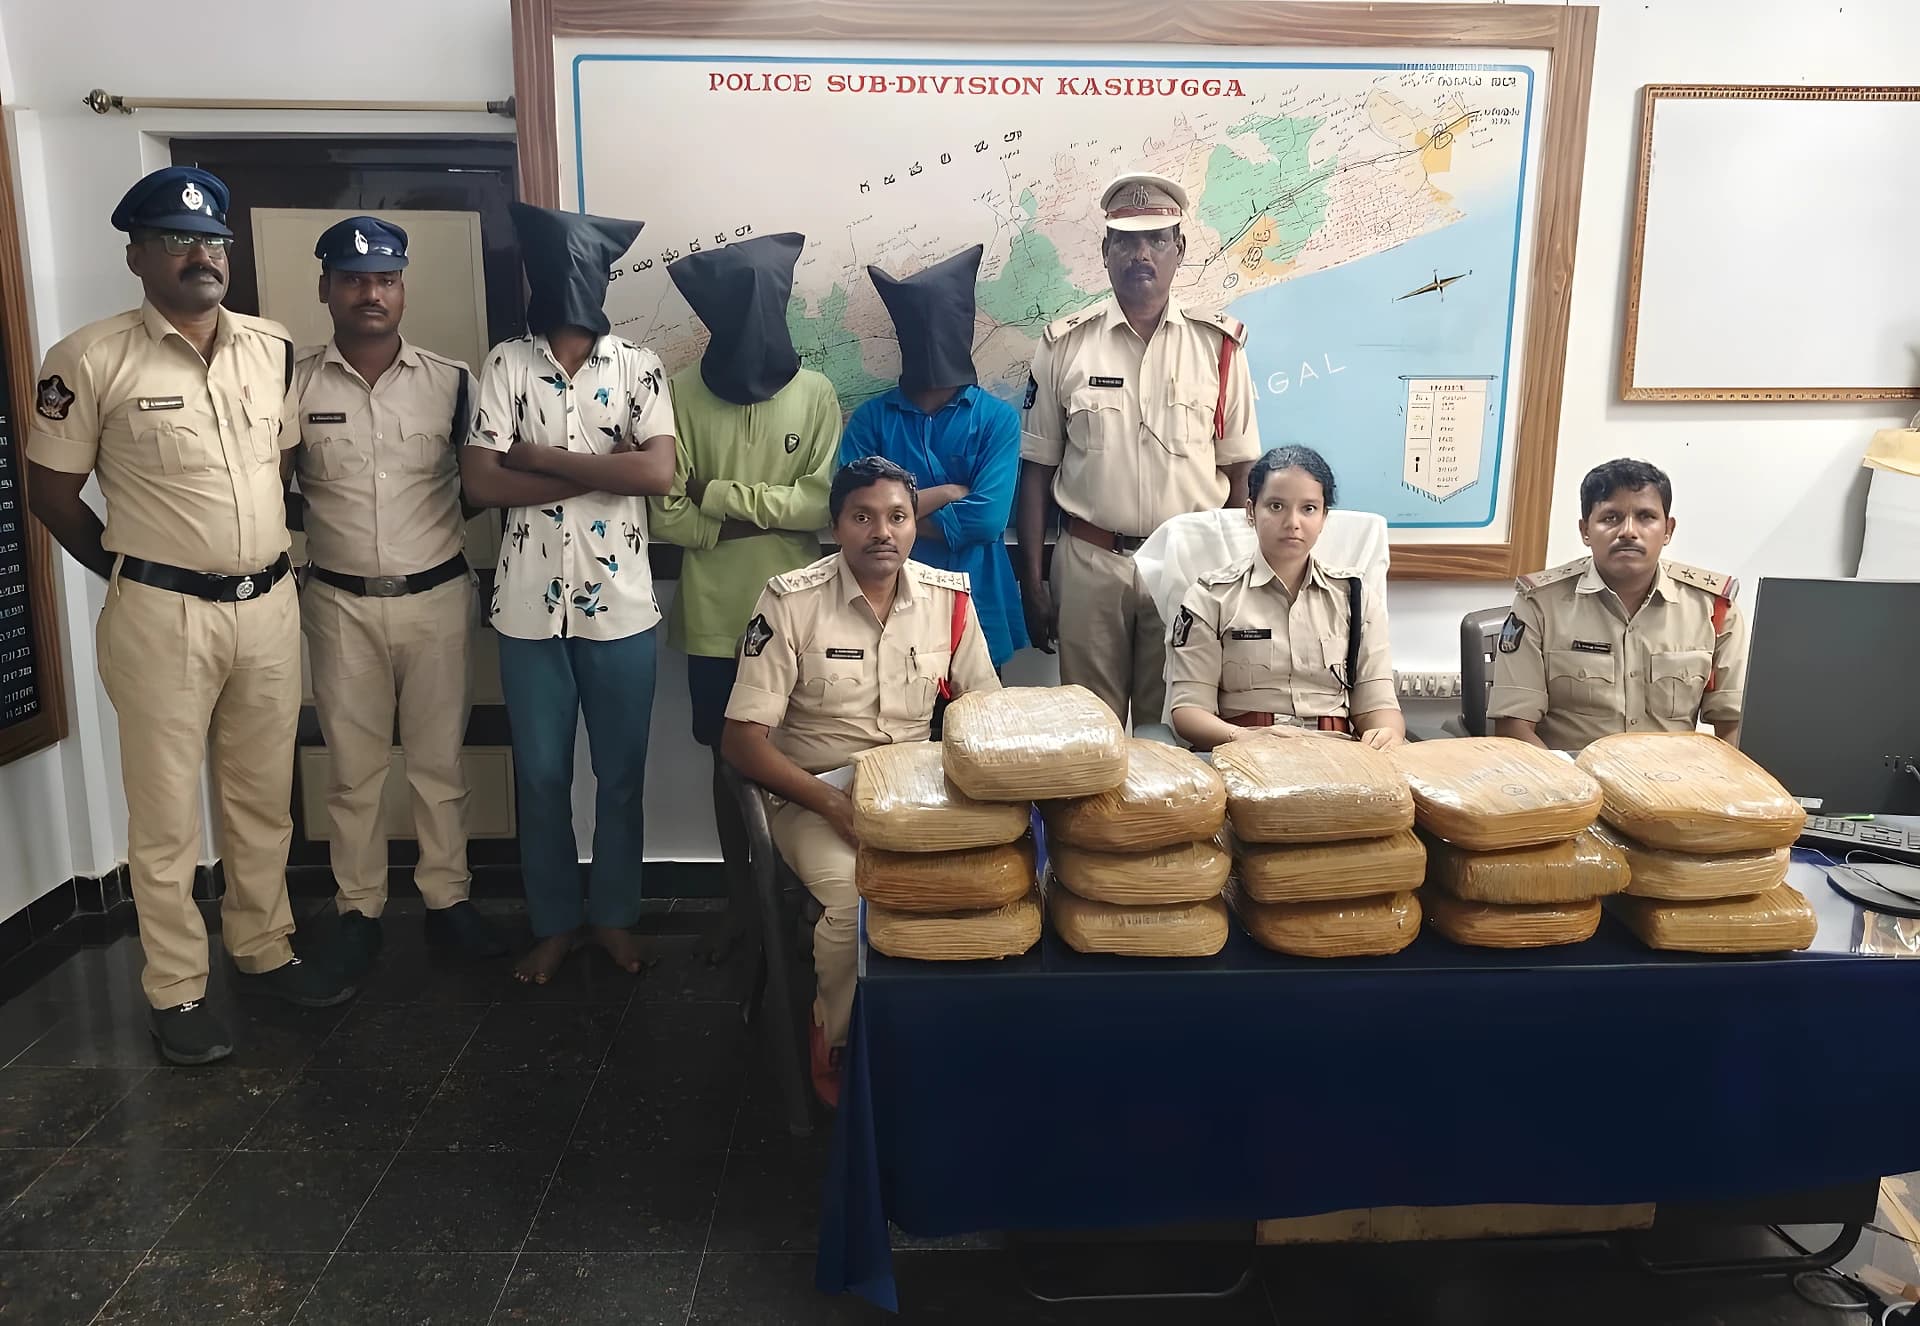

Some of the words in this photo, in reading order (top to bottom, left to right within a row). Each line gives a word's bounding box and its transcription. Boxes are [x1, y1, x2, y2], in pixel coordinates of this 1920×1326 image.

[709, 73, 811, 92] POLICE
[827, 75, 1043, 95] SUB-DIVISION
[1056, 77, 1246, 97] KASIBUGGA
